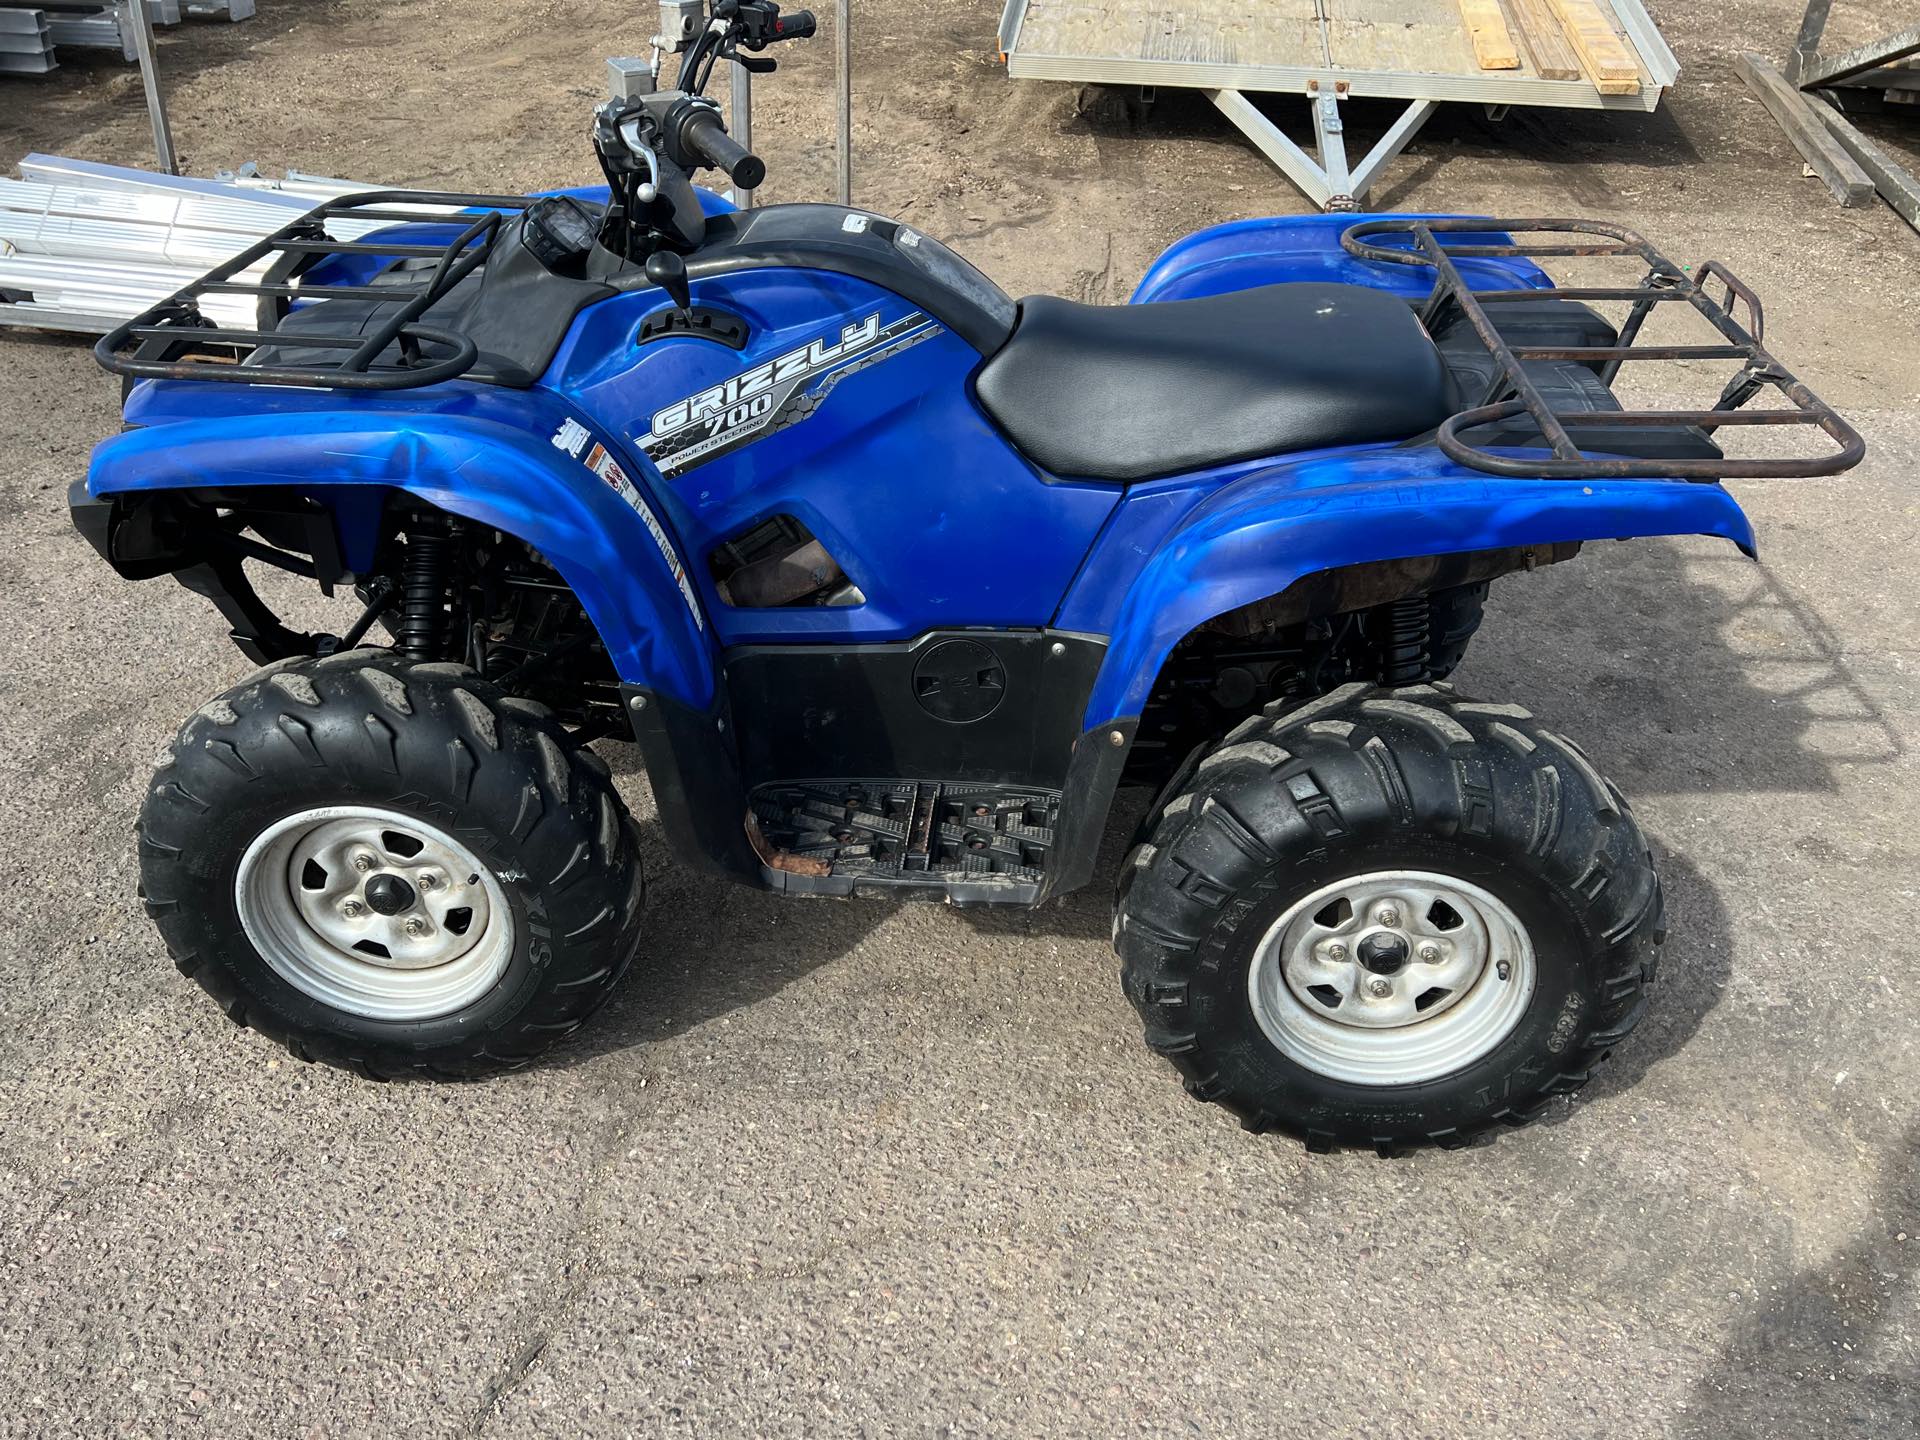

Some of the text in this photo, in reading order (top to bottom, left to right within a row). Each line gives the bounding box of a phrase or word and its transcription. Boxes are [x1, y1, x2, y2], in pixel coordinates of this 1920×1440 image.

[653, 313, 879, 436] GRIZZLY
[671, 418, 765, 464] POWER STEERING
[704, 393, 773, 437] 700
[1546, 990, 1587, 1054] 489
